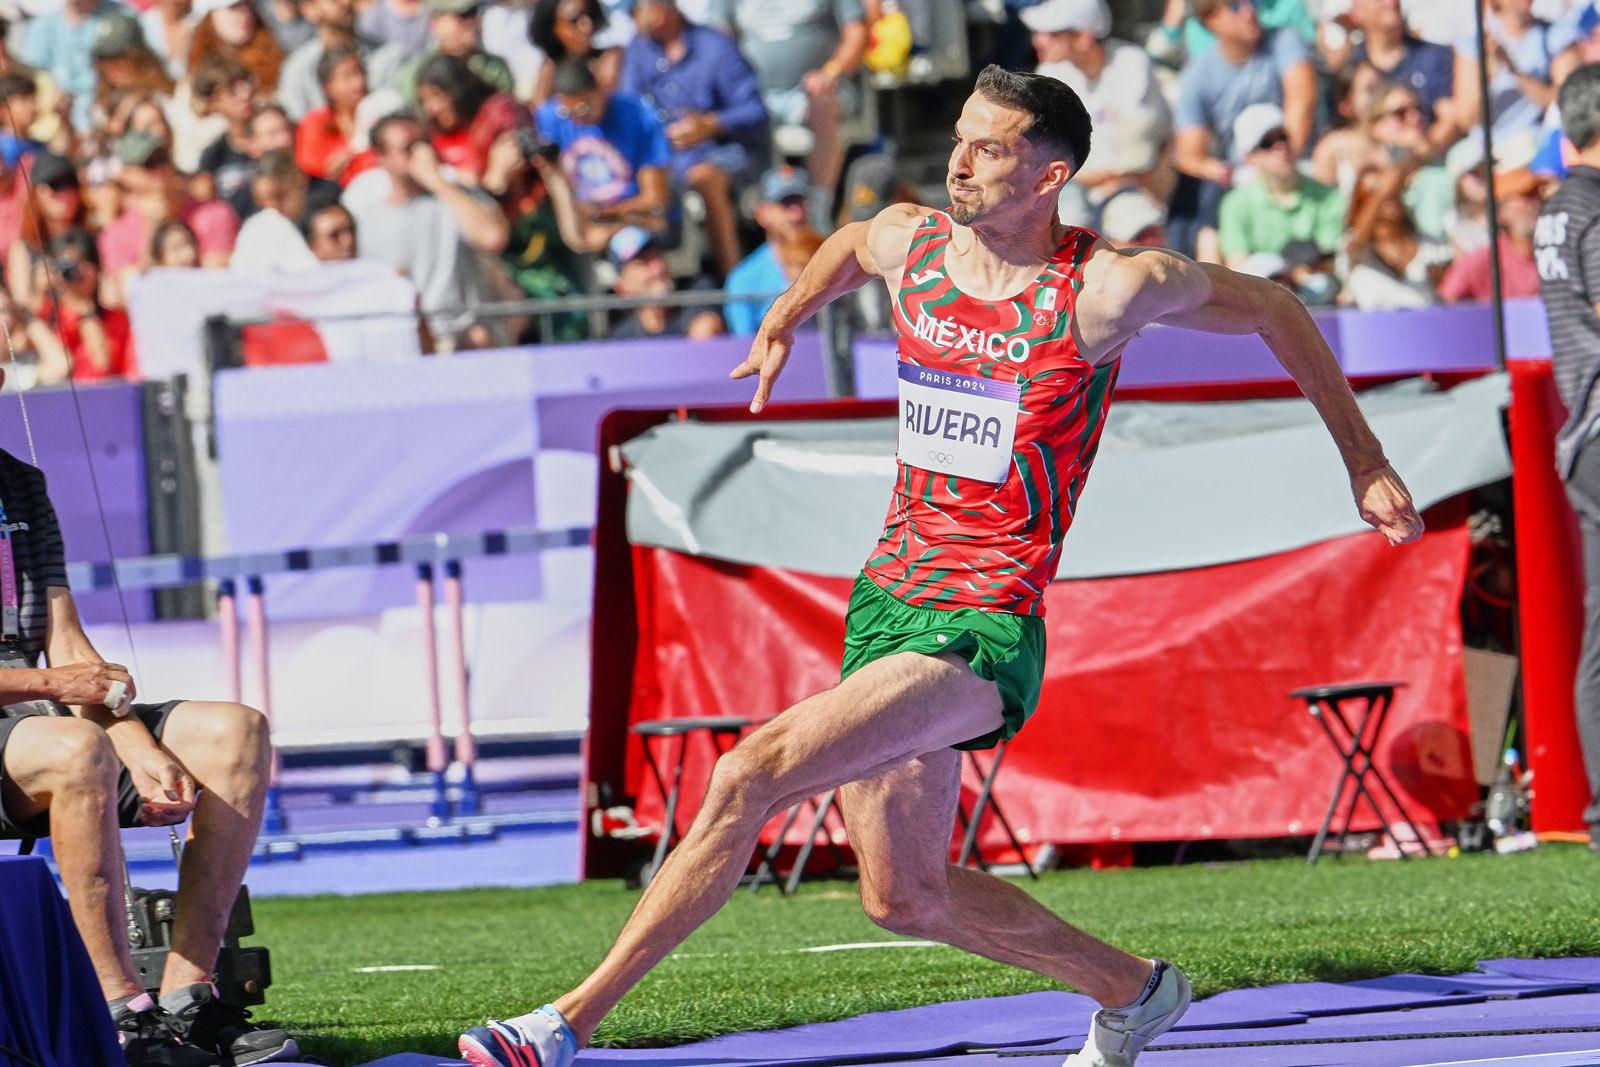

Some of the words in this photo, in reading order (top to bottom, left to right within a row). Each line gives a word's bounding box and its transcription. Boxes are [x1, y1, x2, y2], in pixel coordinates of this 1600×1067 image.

[913, 312, 1030, 363] MÉXICO
[919, 371, 952, 386] PARIS
[955, 378, 986, 392] 2024
[906, 400, 1001, 448] RIVERA
